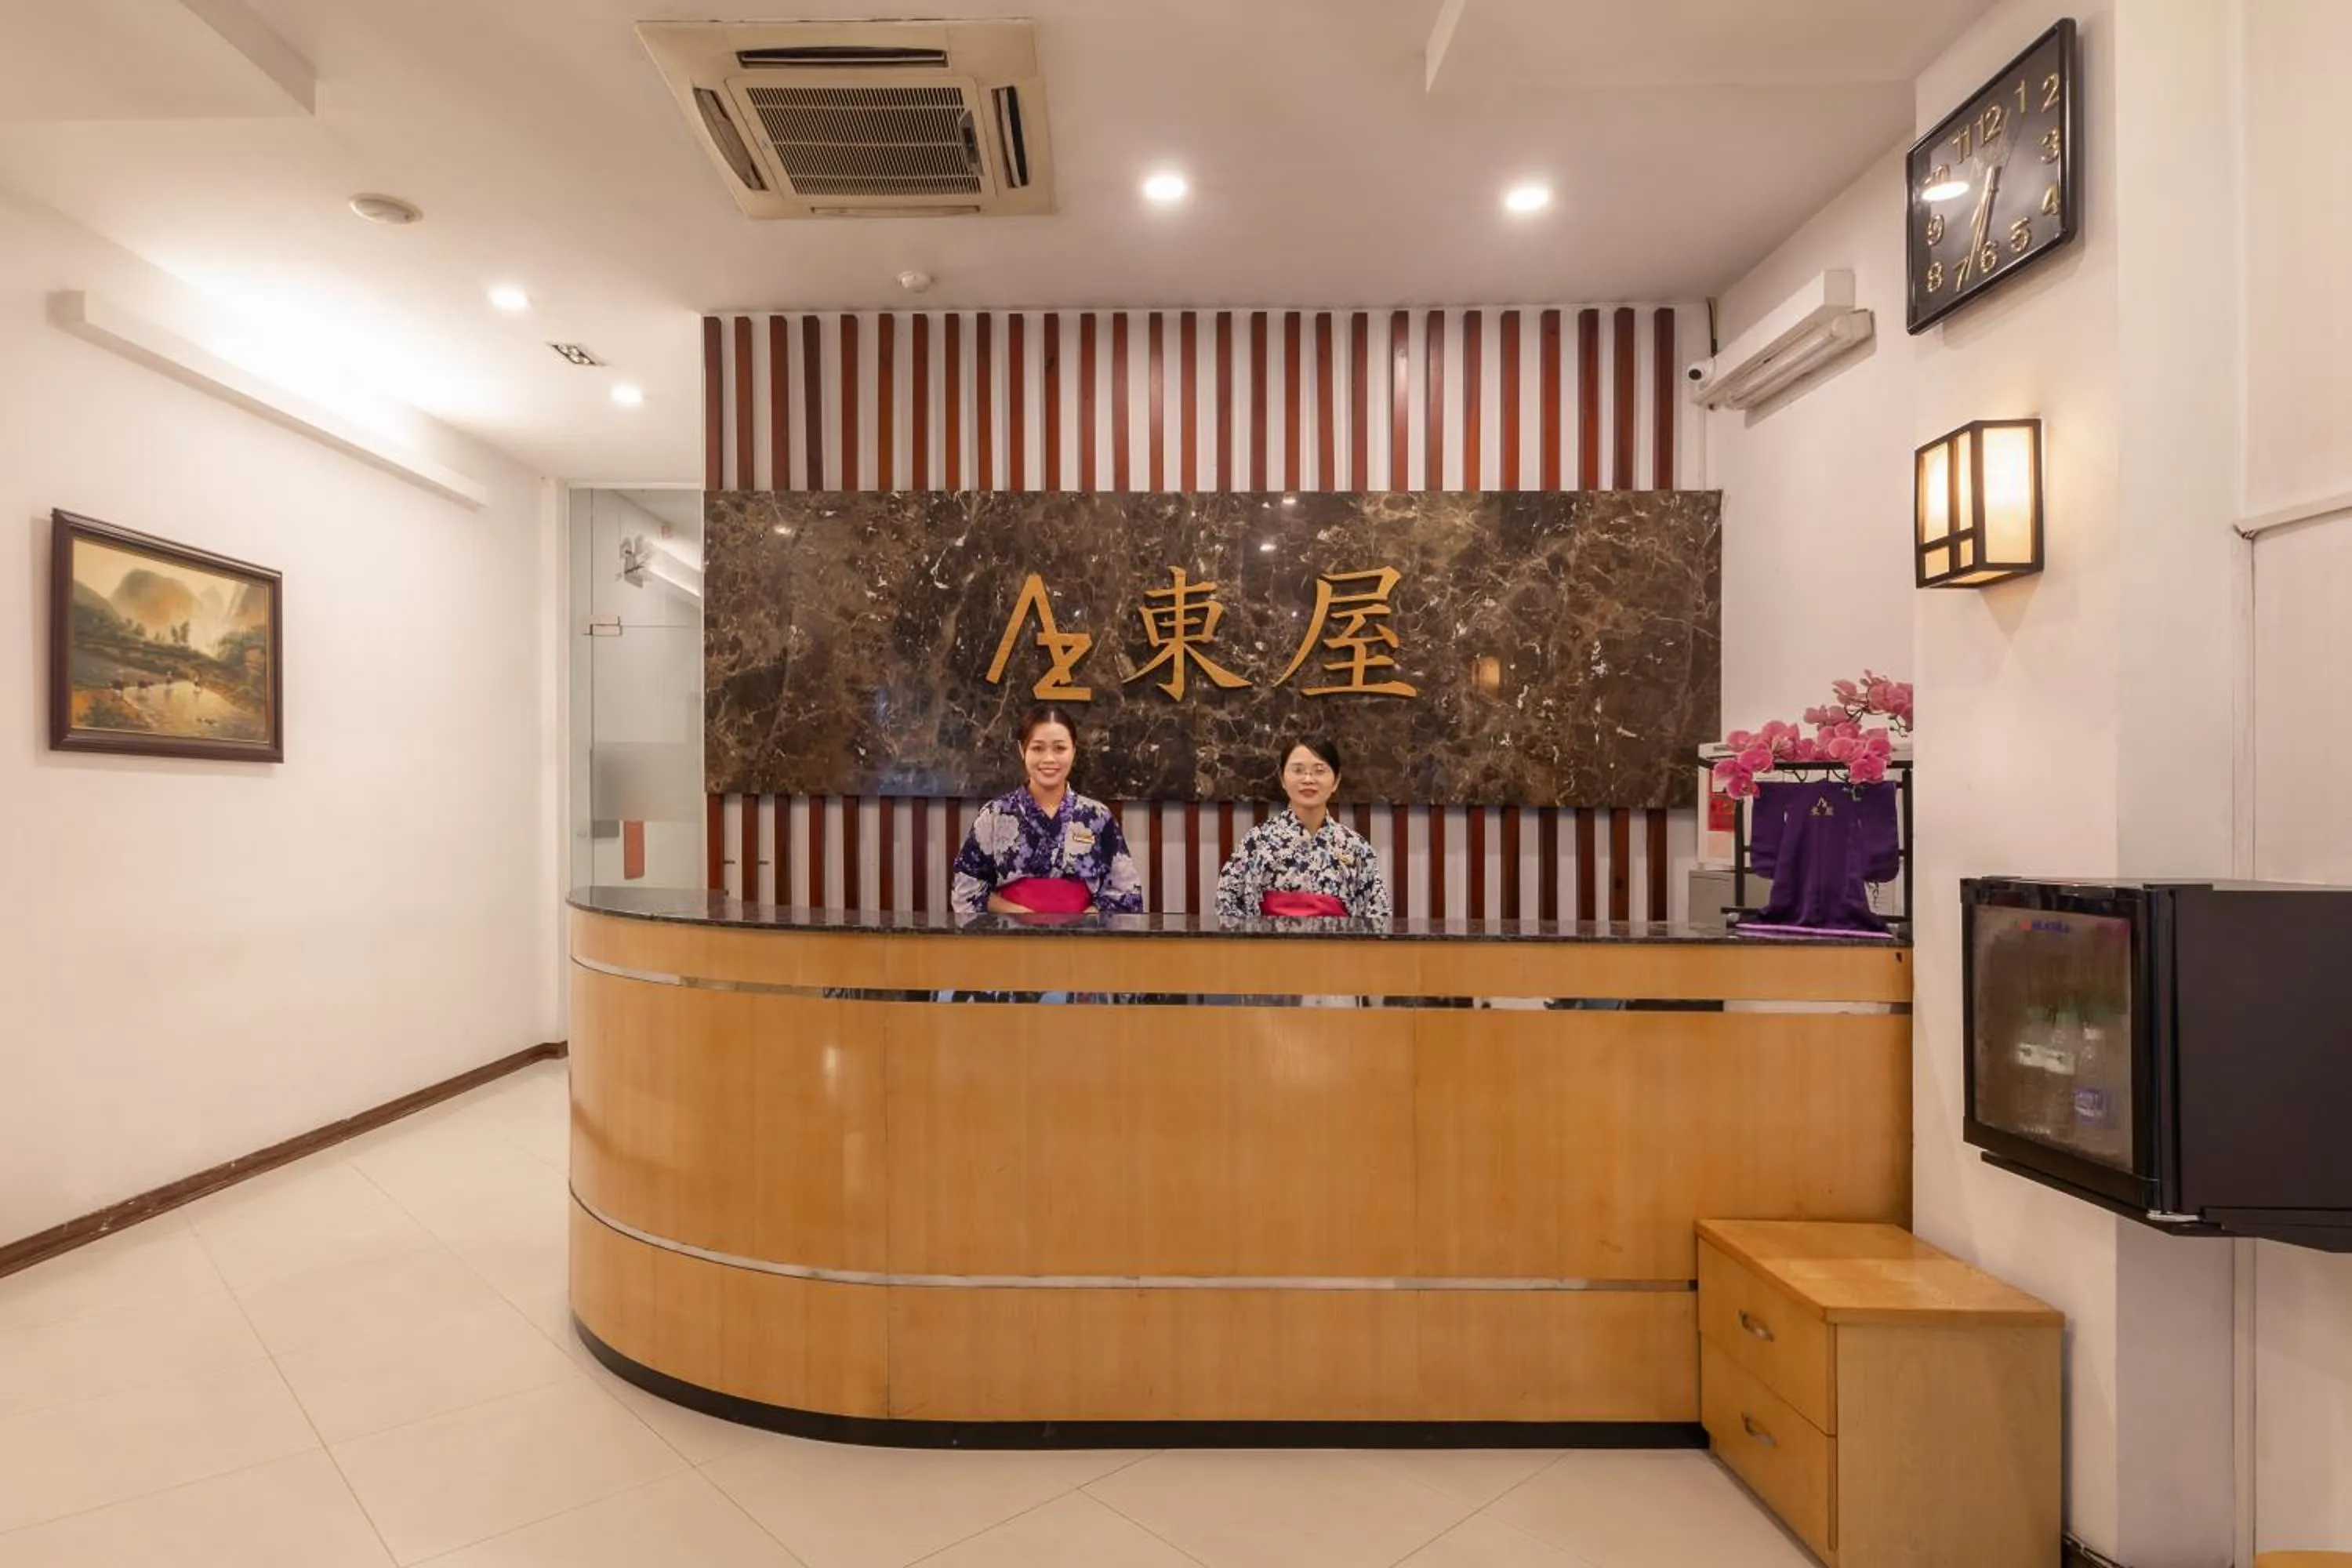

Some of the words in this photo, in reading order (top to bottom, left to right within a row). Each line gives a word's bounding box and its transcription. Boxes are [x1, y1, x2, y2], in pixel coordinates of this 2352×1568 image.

[2014, 79, 2027, 114] 1
[1974, 103, 2004, 147] 12
[1951, 123, 1973, 165] 11
[1926, 212, 1946, 247] 9
[2010, 216, 2032, 254] 5
[1953, 255, 1970, 293] 7
[1980, 238, 2000, 274] 6
[1926, 260, 1944, 294] 8
